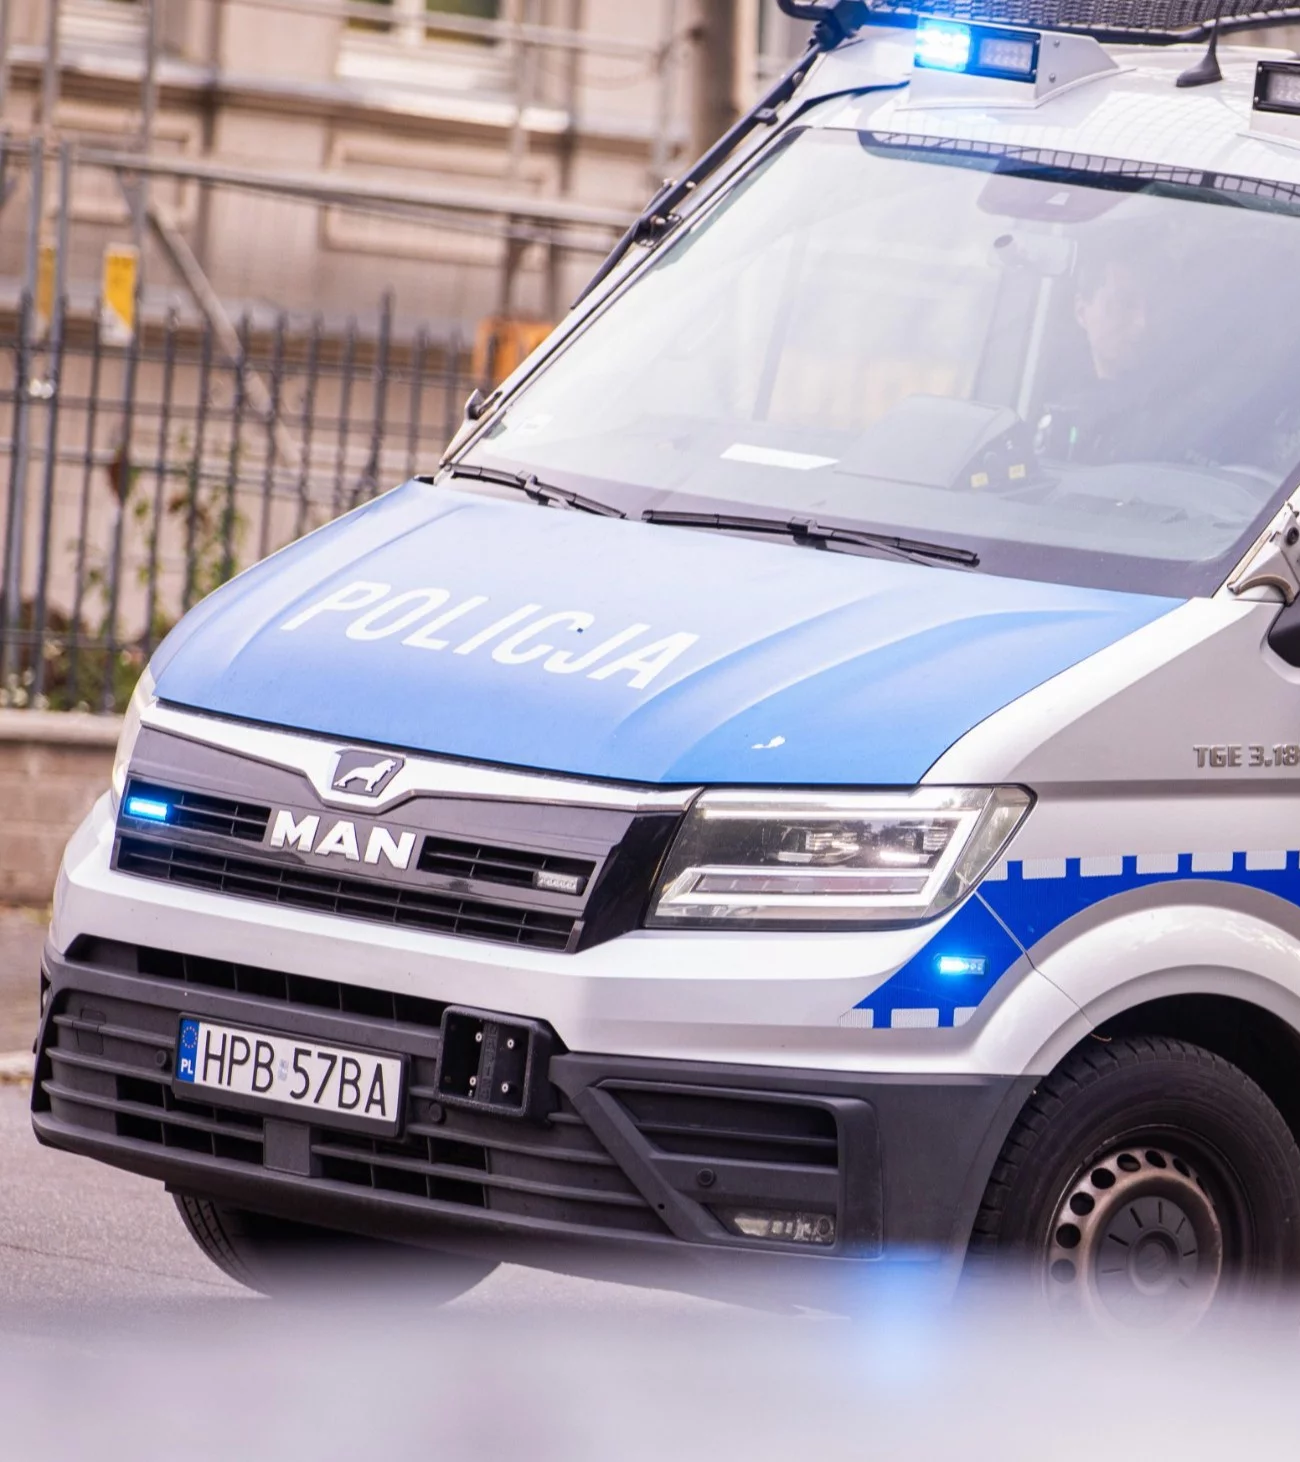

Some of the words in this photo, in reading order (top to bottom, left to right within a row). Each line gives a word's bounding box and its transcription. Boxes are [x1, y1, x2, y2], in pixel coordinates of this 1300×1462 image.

[279, 581, 700, 689] POLICJA
[1193, 744, 1242, 768] TGE
[270, 809, 416, 870] MAN
[180, 1058, 194, 1074] PL
[202, 1030, 275, 1093] HPB
[289, 1047, 387, 1117] 57BA
